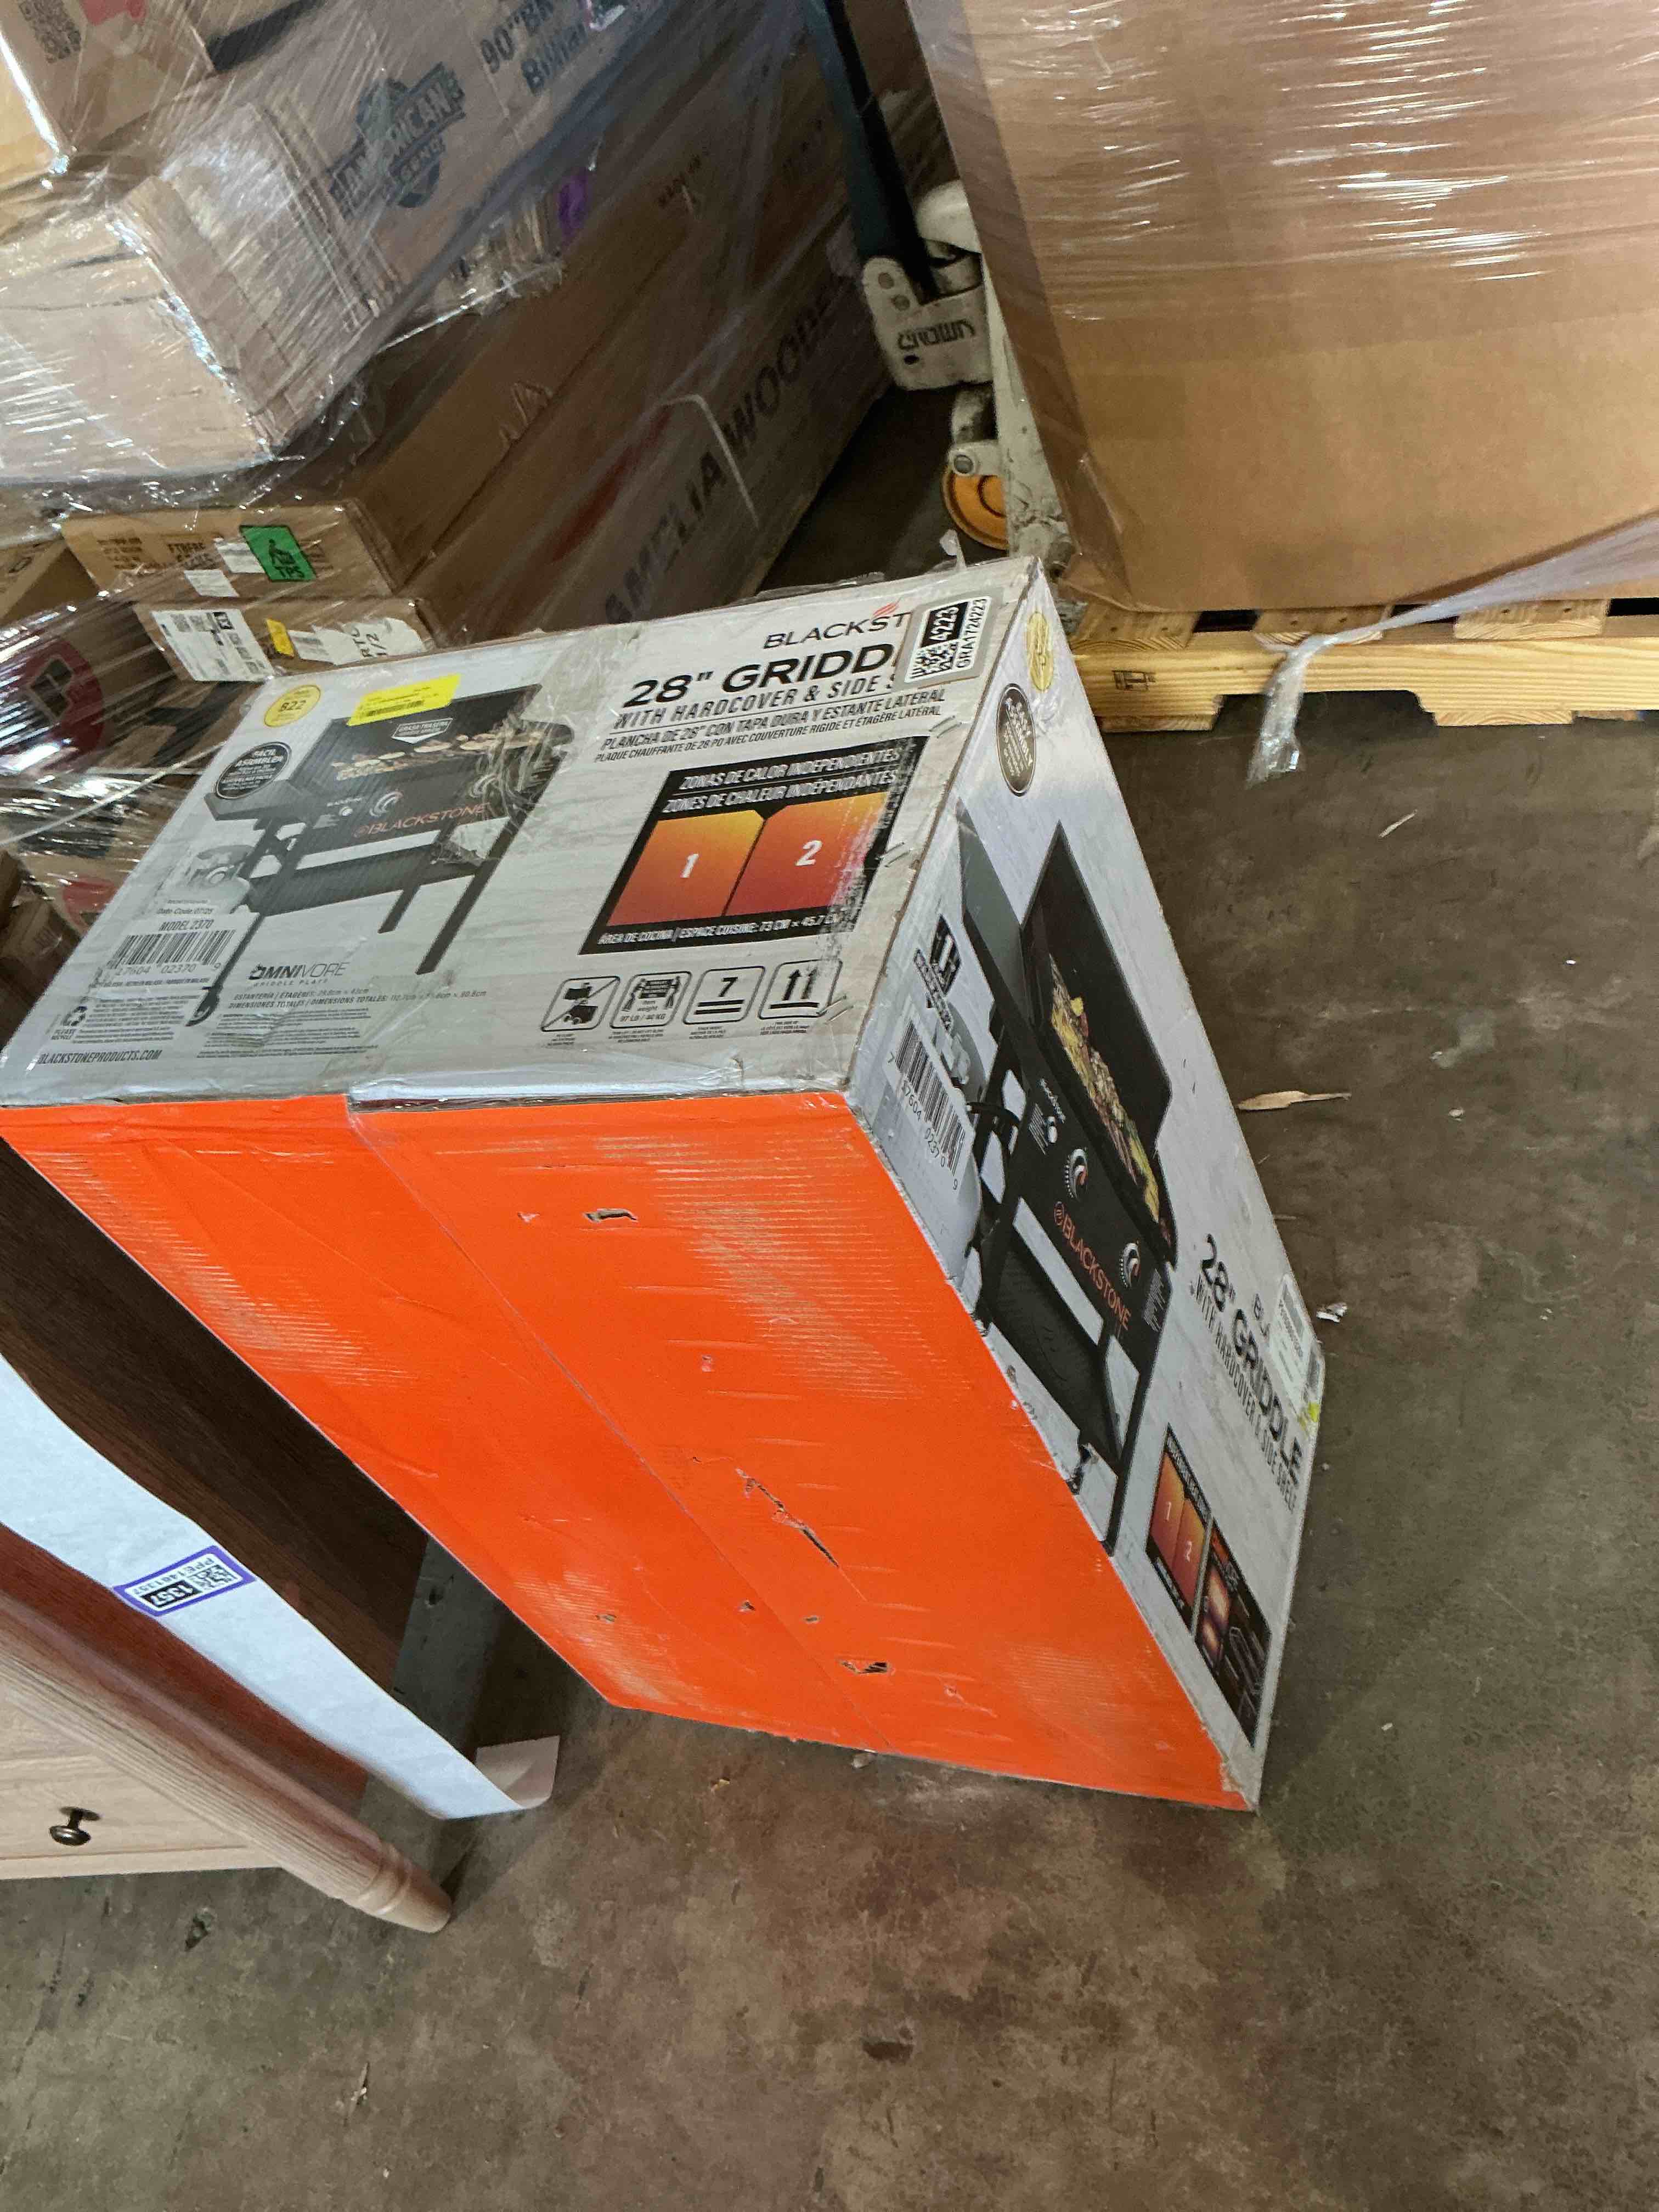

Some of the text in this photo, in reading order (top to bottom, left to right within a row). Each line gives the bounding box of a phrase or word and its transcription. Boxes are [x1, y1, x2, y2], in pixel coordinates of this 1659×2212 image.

[928, 606, 960, 642] 4223
[955, 598, 988, 669] GRA1724223
[623, 643, 896, 708] 28" GRIDD
[613, 707, 668, 730] WITH
[670, 688, 798, 722] HARDCOVER
[803, 685, 820, 703] &
[827, 675, 881, 699] SIDE
[601, 731, 659, 751] PLANCHA
[706, 721, 736, 737] CON
[736, 715, 769, 732] TAPA
[770, 711, 809, 728] DURA
[822, 698, 885, 720] ESTANTE
[885, 689, 945, 711] LATERAL
[595, 751, 628, 763] PLAQUE
[629, 743, 685, 759] CHAUFFANTE
[685, 742, 697, 751] DE
[724, 733, 747, 746] AVEC
[748, 725, 809, 742] COUVERTURE
[810, 719, 840, 733] RIGIDE
[842, 718, 855, 729] ET
[368, 802, 490, 834] BLACKSTONE
[681, 854, 699, 878] 1
[795, 840, 823, 867] 2
[158, 919, 215, 932] MODEL 2370
[719, 977, 738, 997] 7
[37, 1049, 163, 1064] BLACKSTONEPRODUCTS.COM
[952, 1178, 958, 1190] 9
[1062, 1212, 1132, 1331] BLACKSTONE
[150, 1583, 194, 1608] 1357
